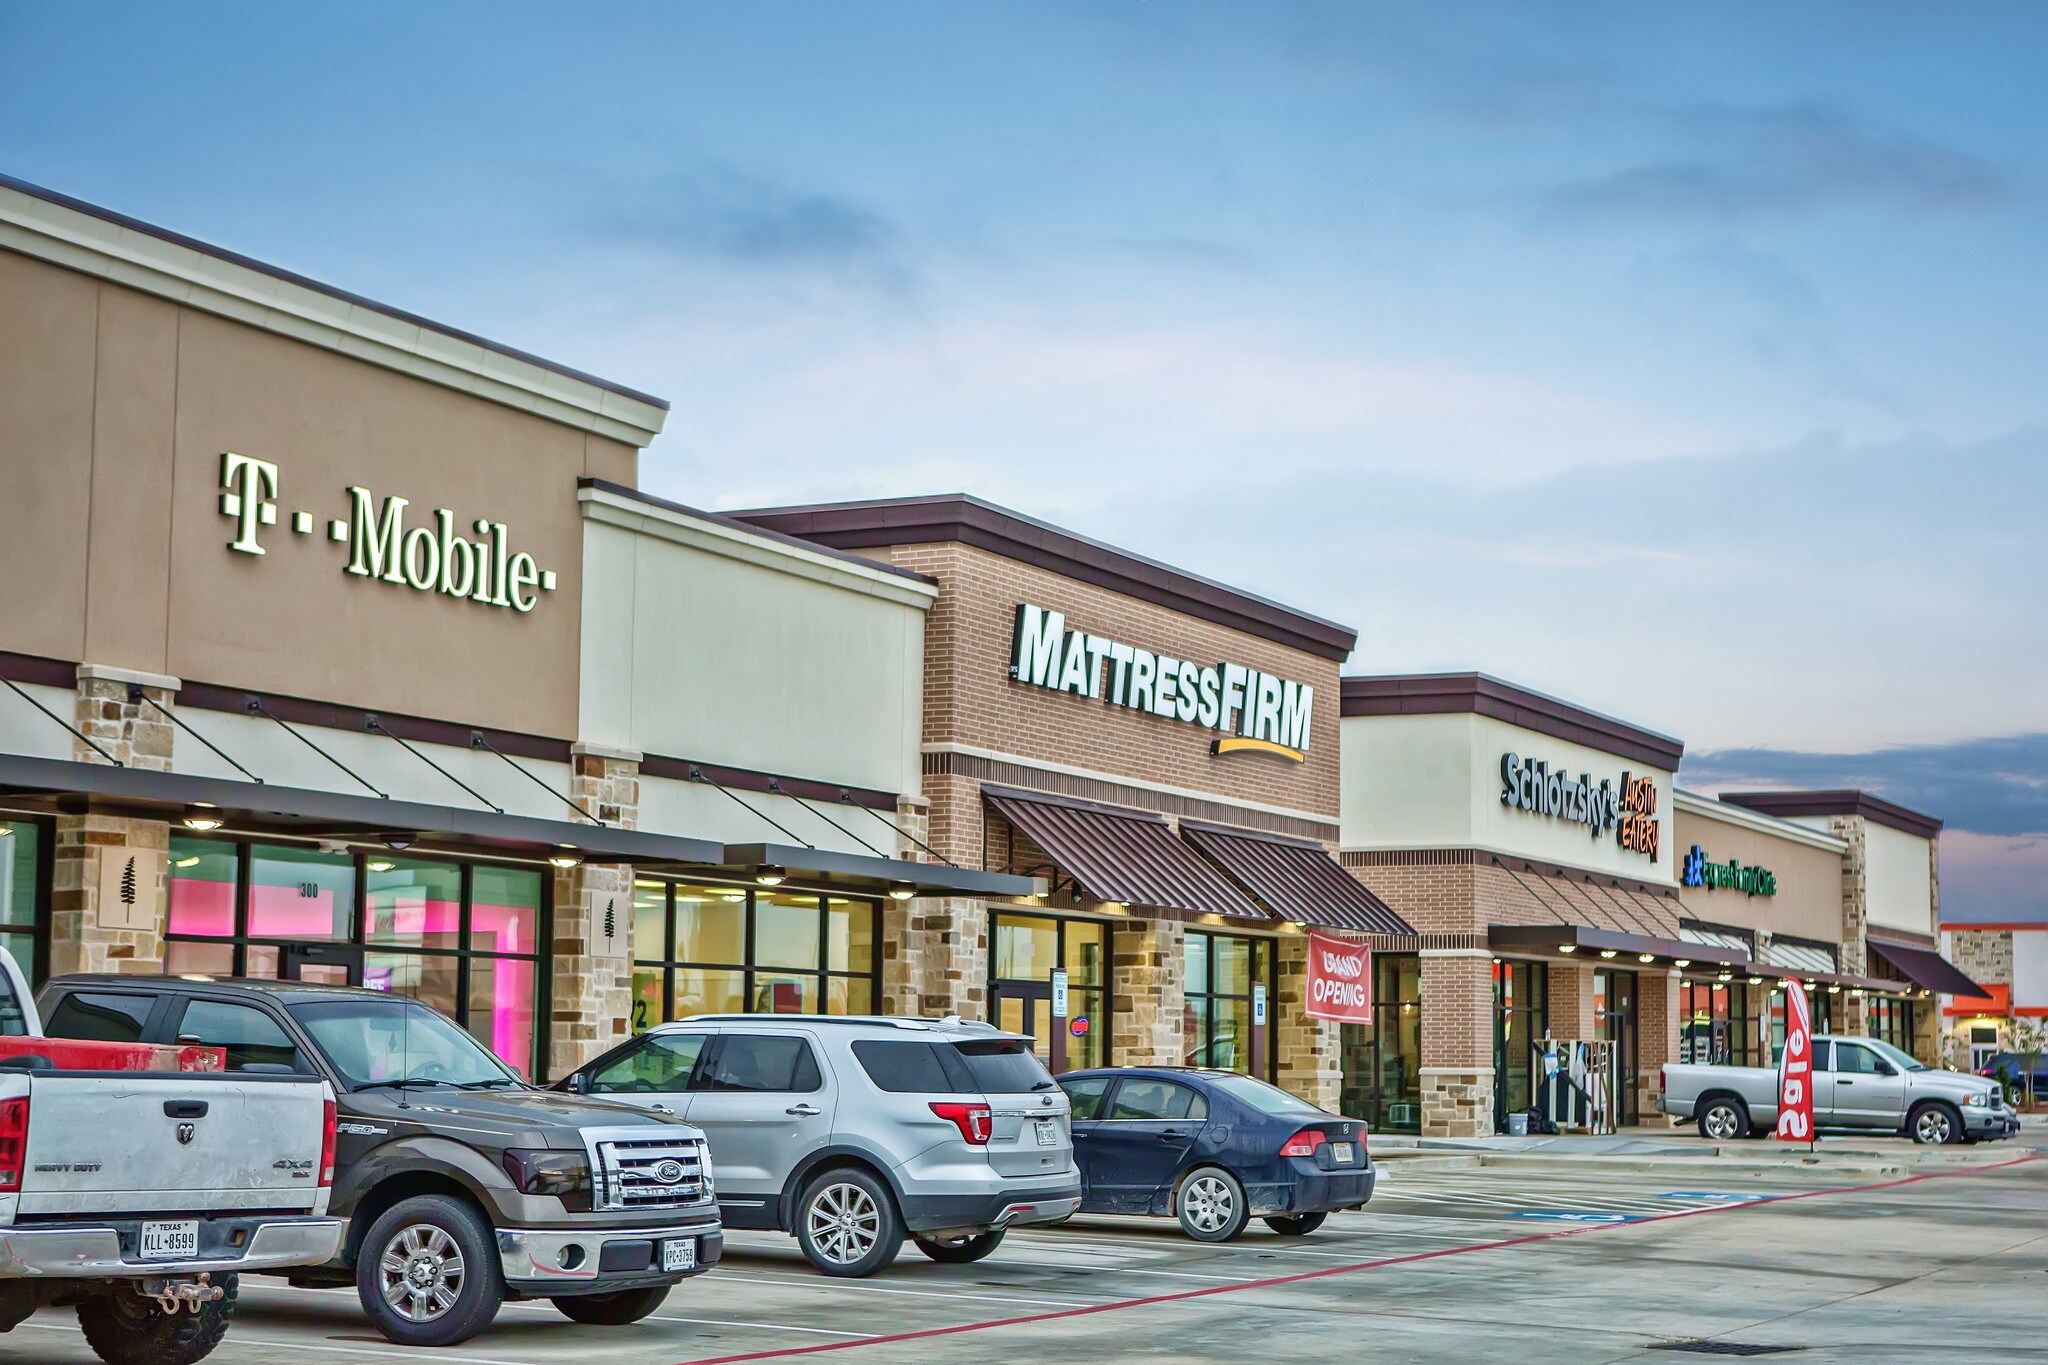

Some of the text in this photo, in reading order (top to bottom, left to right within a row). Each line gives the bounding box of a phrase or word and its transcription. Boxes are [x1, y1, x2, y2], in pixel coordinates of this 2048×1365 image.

[1501, 752, 1618, 838] Schlotzsky's
[1618, 812, 1660, 863] EATERY
[301, 883, 318, 898] 300
[1314, 978, 1365, 1007] OPENING
[73, 1162, 102, 1172] DUTY
[160, 1223, 181, 1231] TEXAS
